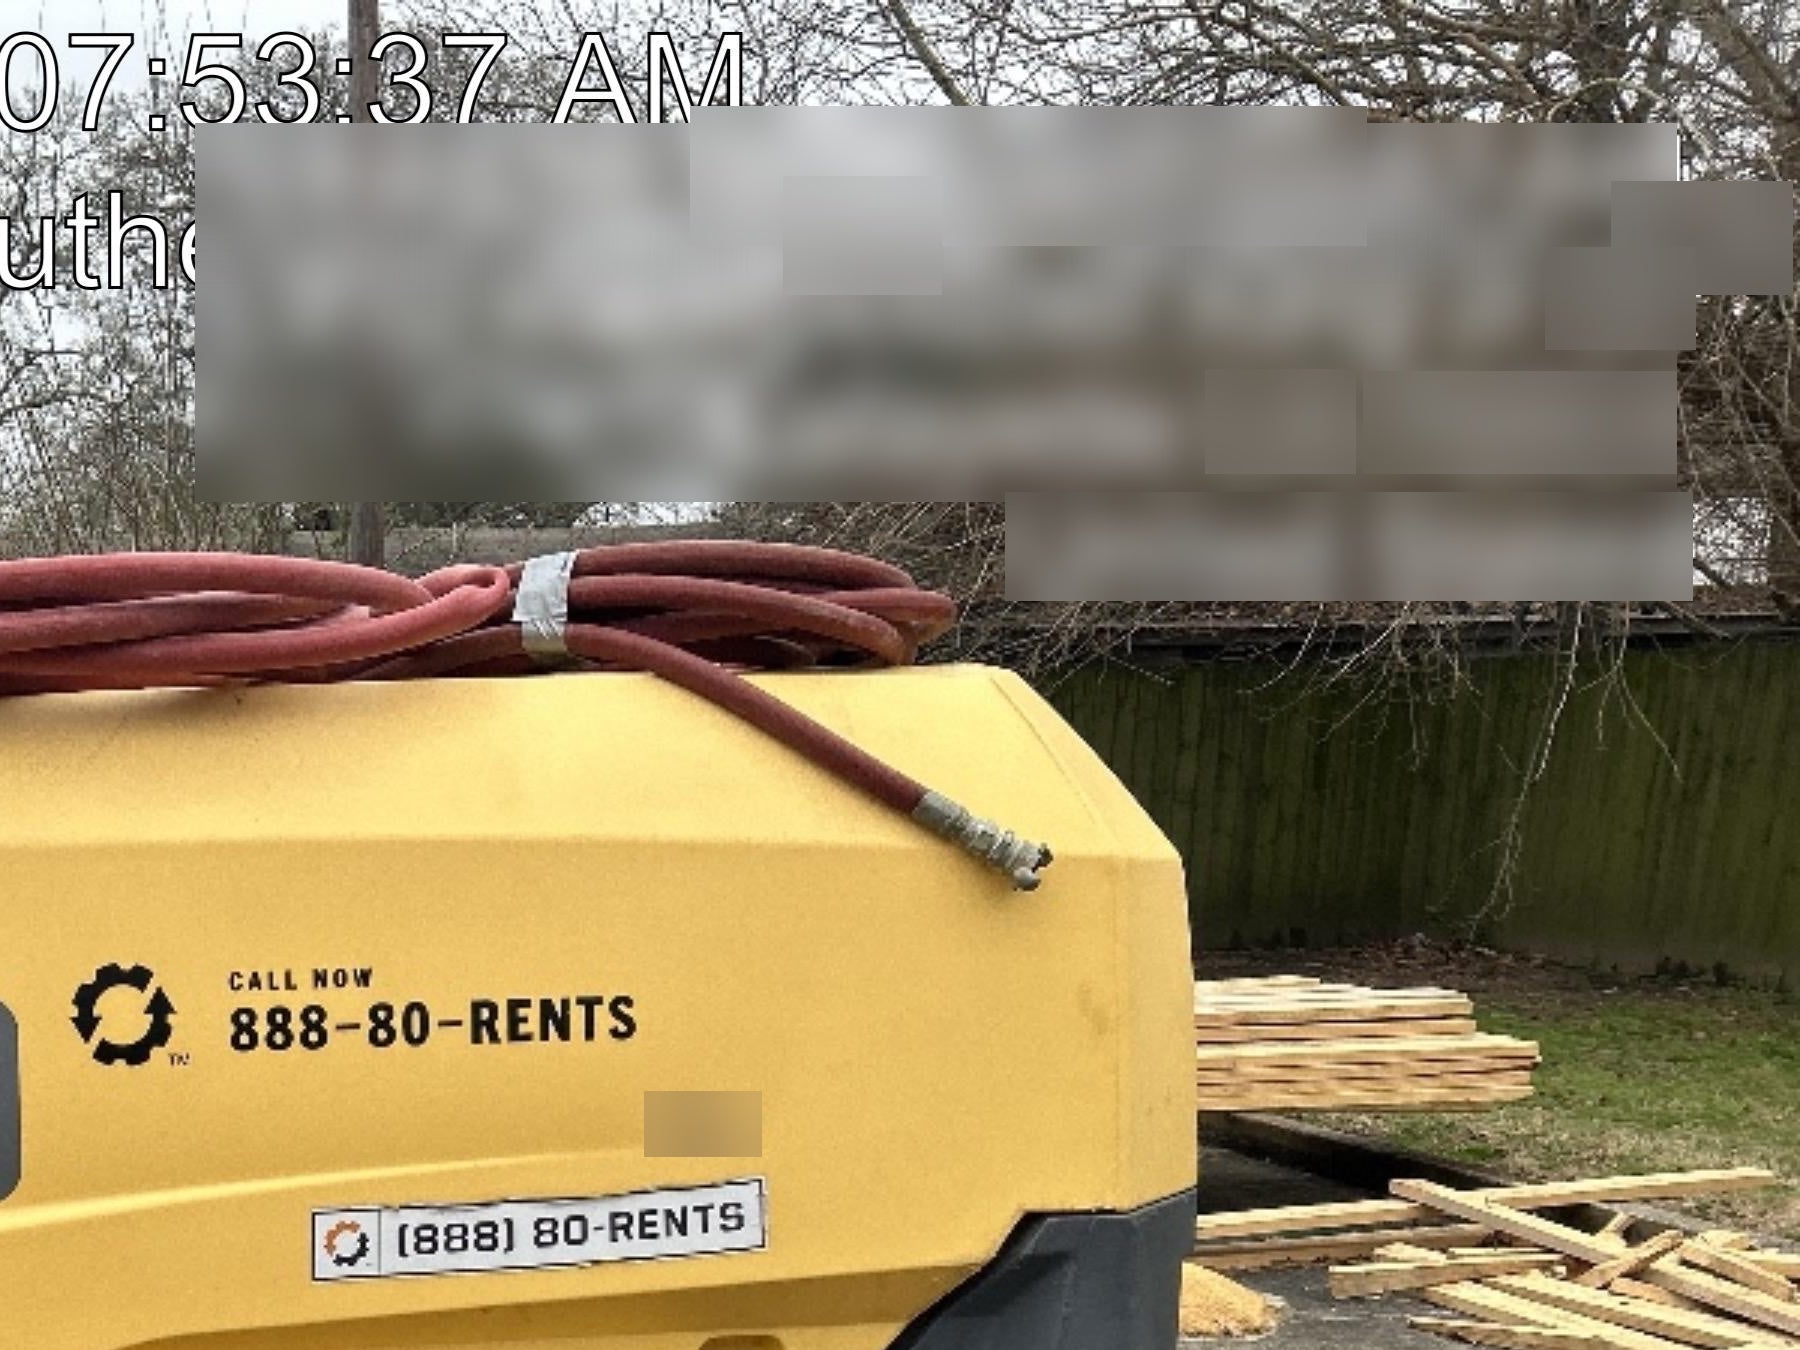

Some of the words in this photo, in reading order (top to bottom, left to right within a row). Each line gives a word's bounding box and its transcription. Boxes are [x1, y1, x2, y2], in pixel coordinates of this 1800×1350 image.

[229, 971, 298, 991] CALL
[312, 967, 373, 989] NOW
[230, 995, 638, 1052] 888-80-RENTS
[533, 1202, 746, 1249] 80-RENTS
